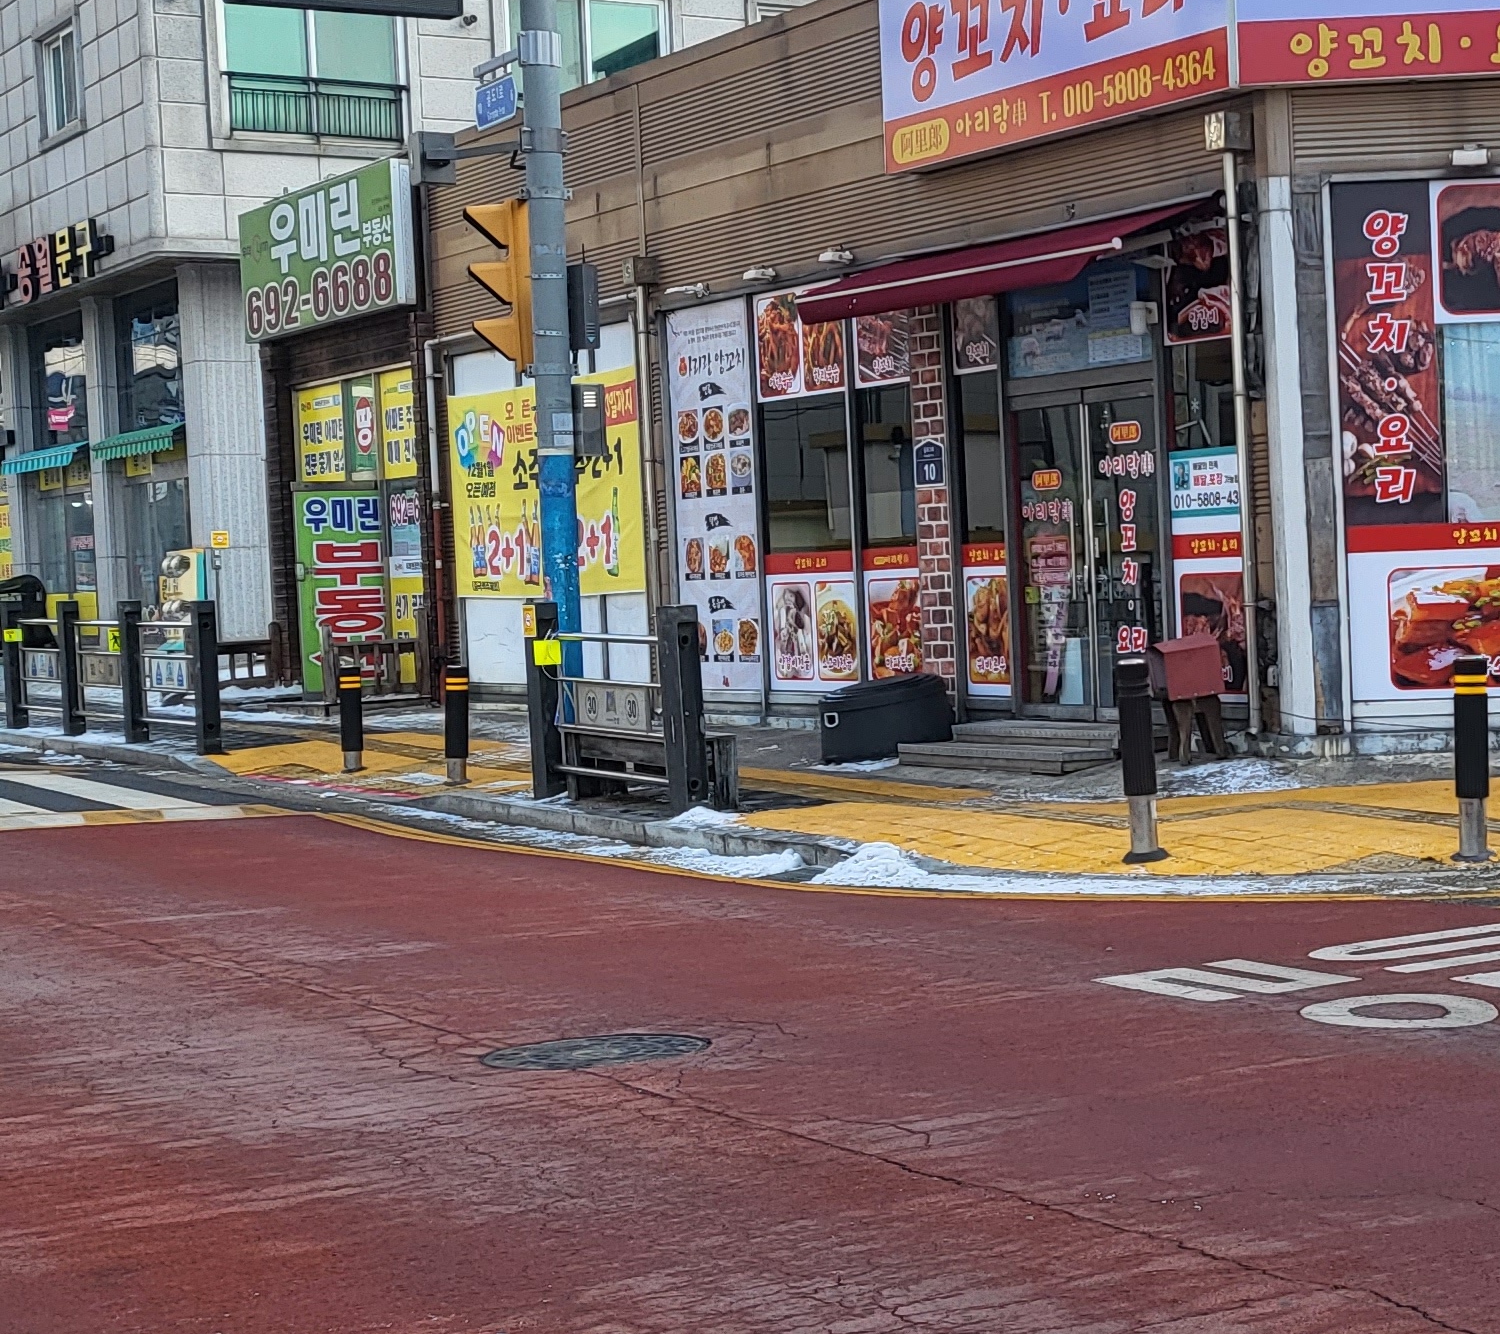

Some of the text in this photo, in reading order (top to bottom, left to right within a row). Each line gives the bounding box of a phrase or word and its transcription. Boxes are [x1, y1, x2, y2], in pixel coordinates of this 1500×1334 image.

[899, 123, 943, 157] 阿里郎
[1062, 46, 1216, 117] 010-5808-4364
[270, 177, 361, 274] 우미린
[362, 214, 392, 249] 부동산
[246, 248, 394, 339] 692-6688
[1188, 306, 1219, 331] 양갈비
[456, 410, 505, 459] OPEN
[506, 421, 534, 444] 이벤트
[923, 463, 936, 481] 10
[303, 496, 383, 535] 우미린
[487, 525, 526, 579] 2+1
[587, 696, 597, 715] 30
[627, 699, 637, 718] 30
